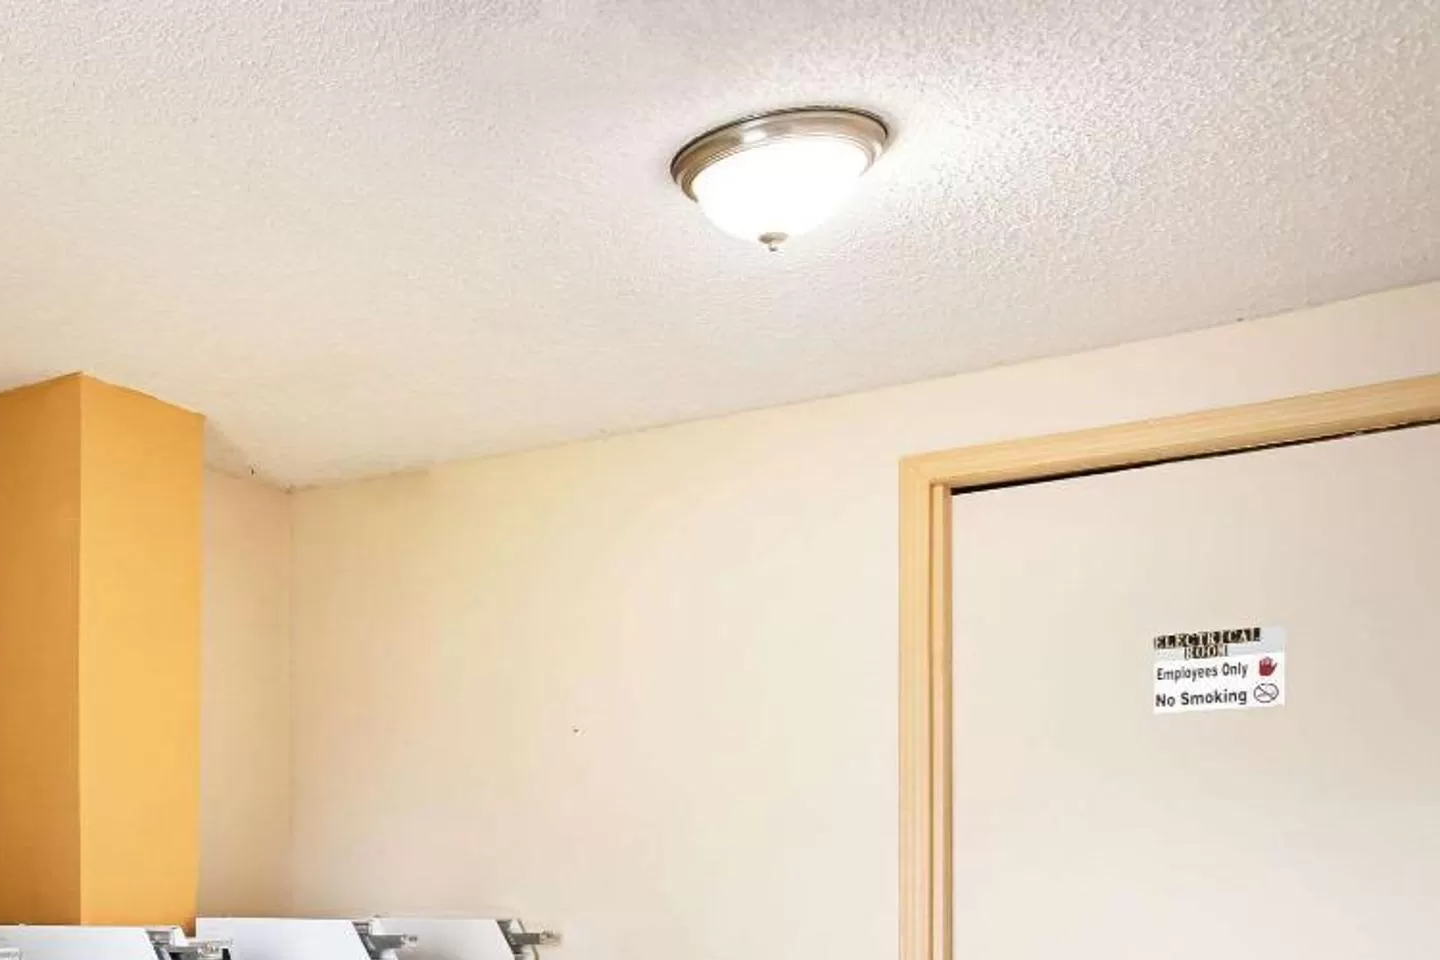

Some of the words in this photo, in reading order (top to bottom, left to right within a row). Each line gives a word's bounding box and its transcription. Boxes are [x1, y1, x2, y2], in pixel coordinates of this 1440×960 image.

[1154, 627, 1261, 649] ELECTRICAL
[1157, 666, 1218, 683] Employees
[1222, 661, 1248, 677] Only
[1155, 694, 1176, 707] No
[1180, 689, 1247, 705] Smoking
